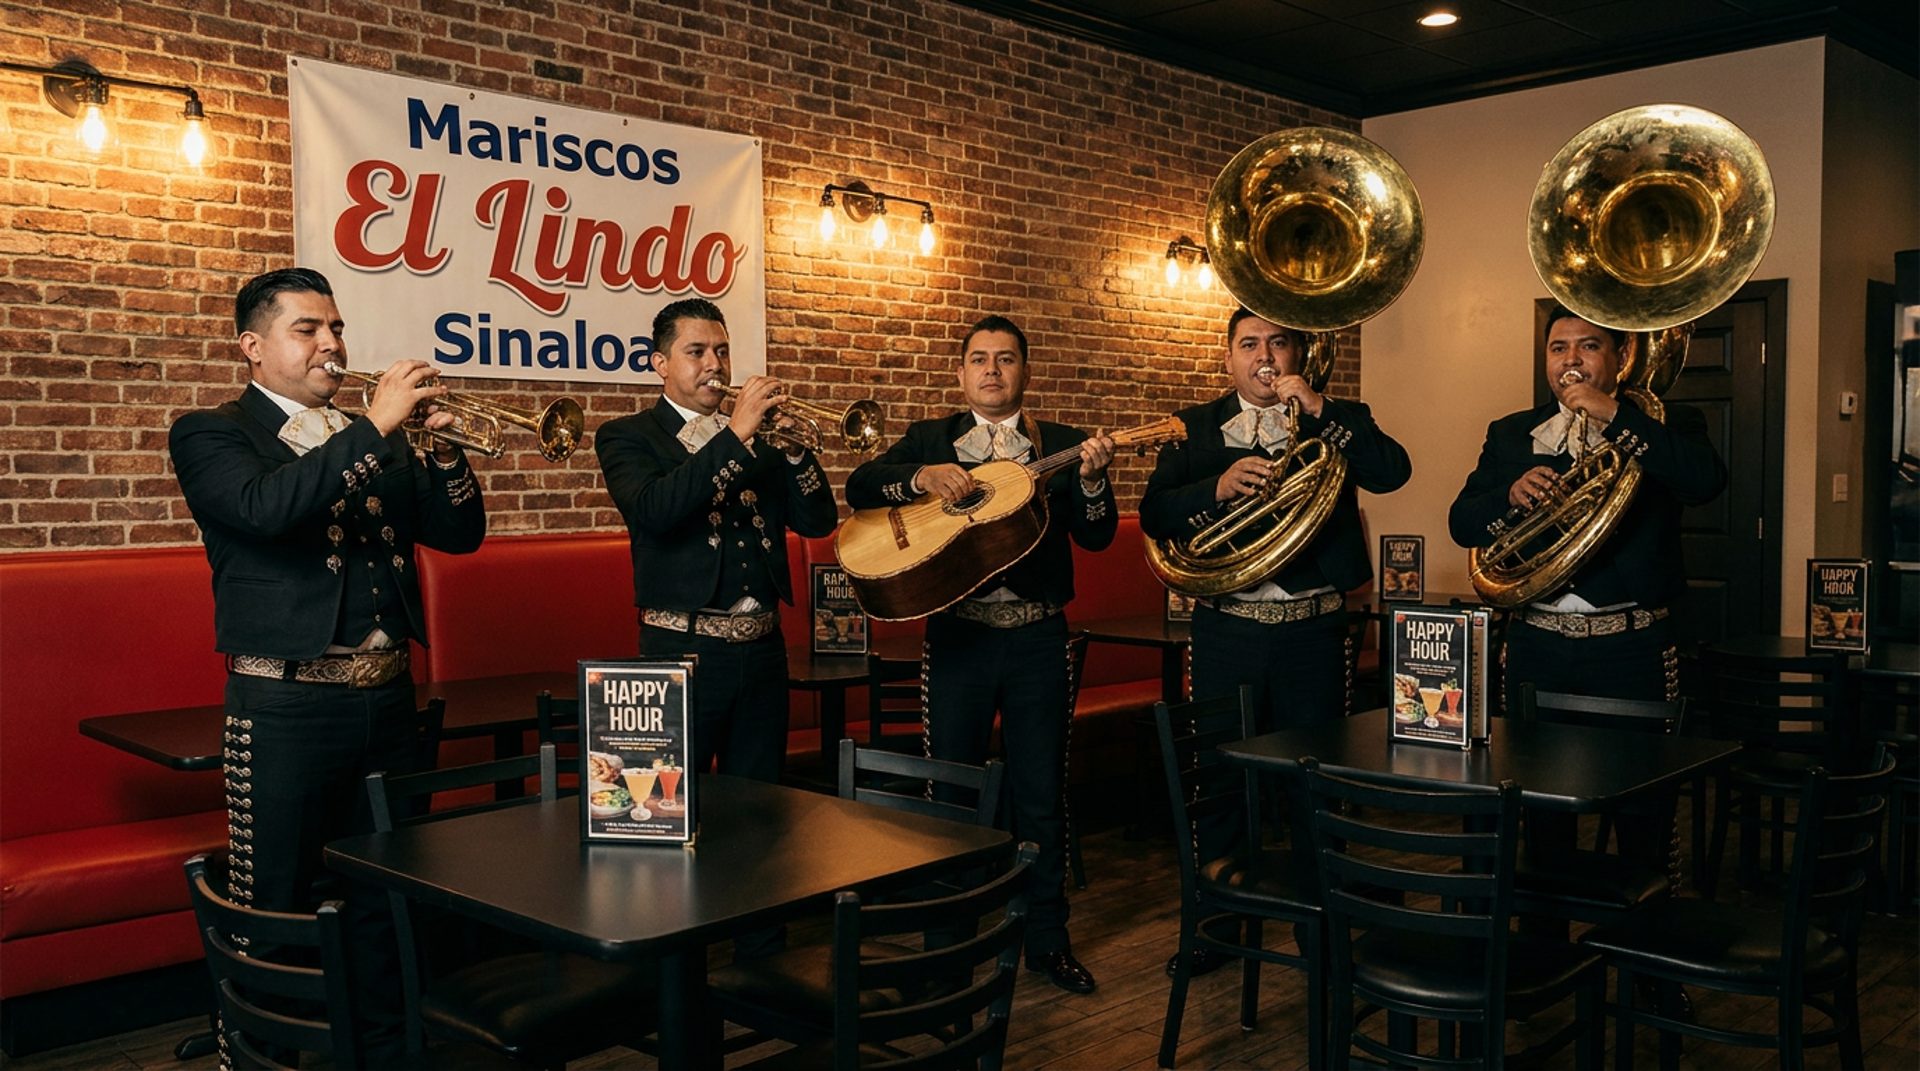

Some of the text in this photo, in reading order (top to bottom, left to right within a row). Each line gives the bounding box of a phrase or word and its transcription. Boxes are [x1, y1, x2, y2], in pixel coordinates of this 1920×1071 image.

[407, 97, 680, 185] Mariscos
[333, 159, 747, 314] El Lindo
[434, 313, 655, 372] Sinaloa
[1406, 620, 1455, 642] HAPPY
[1410, 640, 1450, 661] HOUR
[603, 679, 669, 705] HAPPY
[609, 706, 664, 732] HOUR
